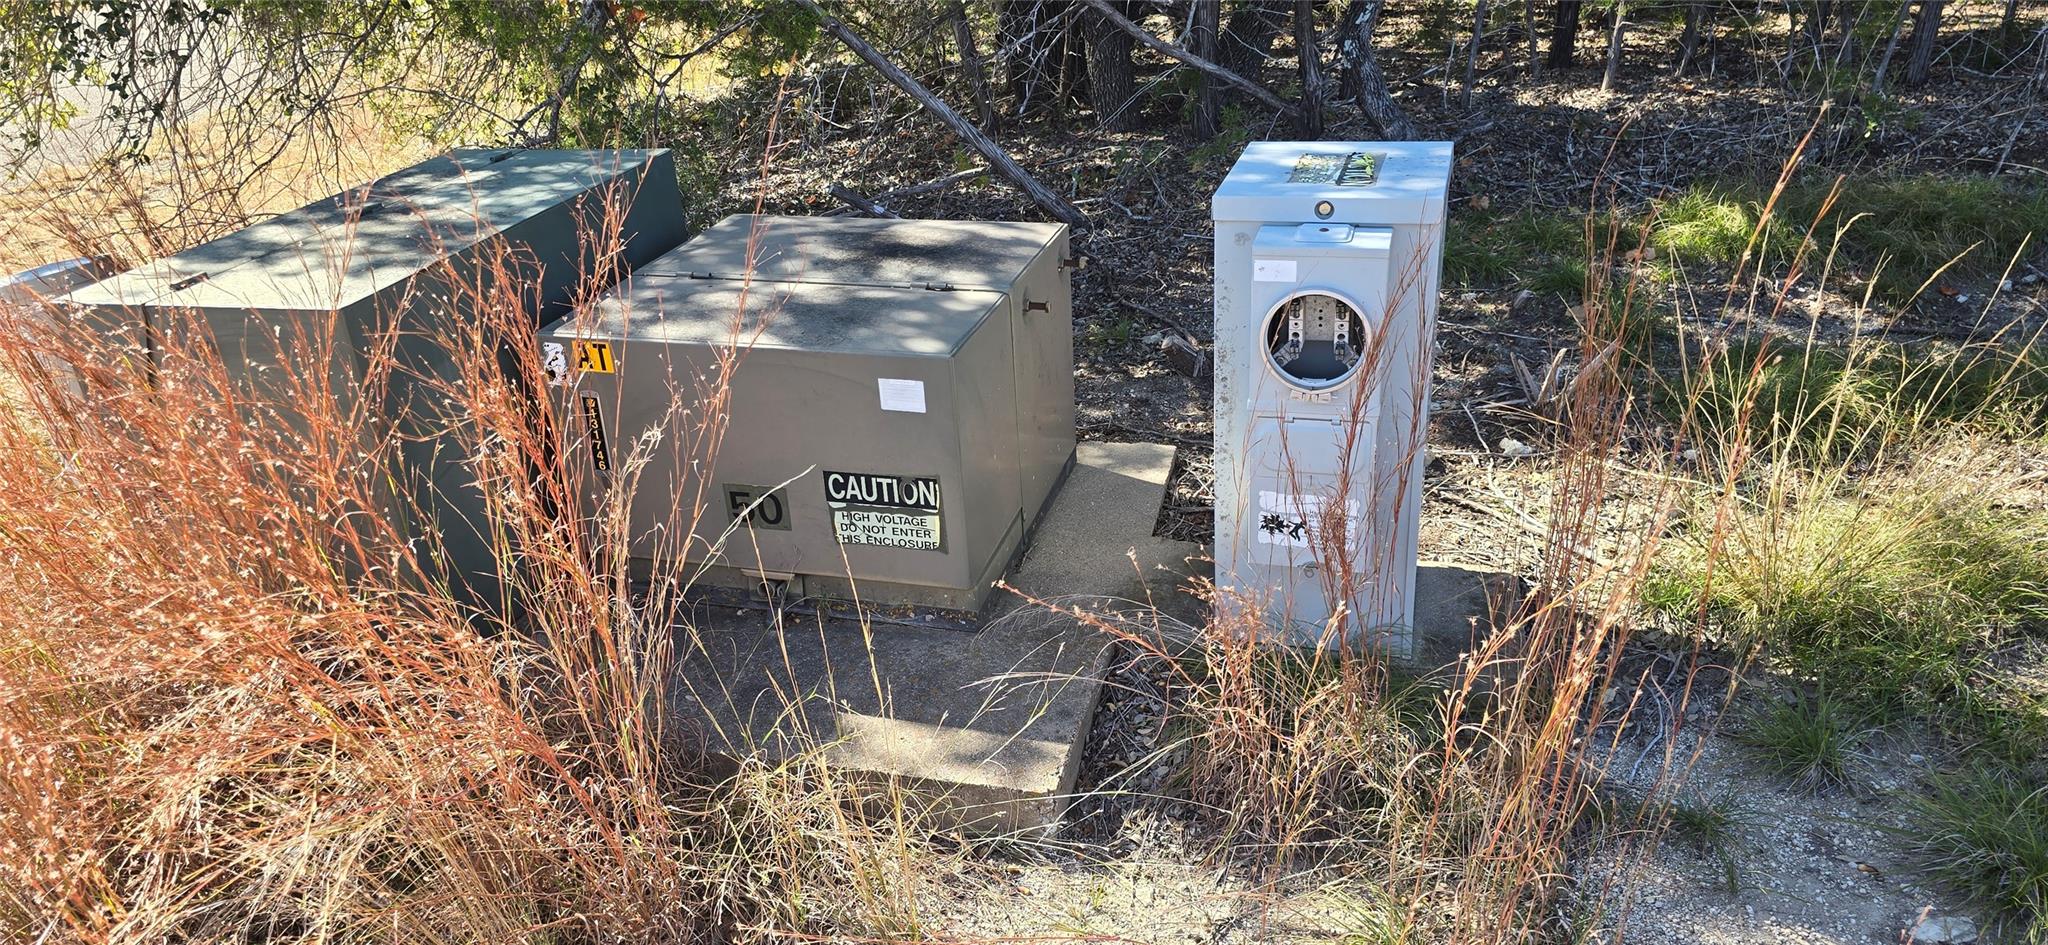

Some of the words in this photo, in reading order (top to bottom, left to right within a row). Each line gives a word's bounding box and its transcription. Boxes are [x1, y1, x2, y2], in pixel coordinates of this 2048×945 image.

[828, 473, 936, 506] CAUTION
[729, 491, 783, 525] 50
[842, 512, 870, 523] HIGH
[875, 514, 928, 528] VOLTAGE
[839, 533, 861, 544] HIS
[840, 523, 858, 533] DO
[863, 525, 887, 535] NOT
[892, 527, 932, 539] ENTER
